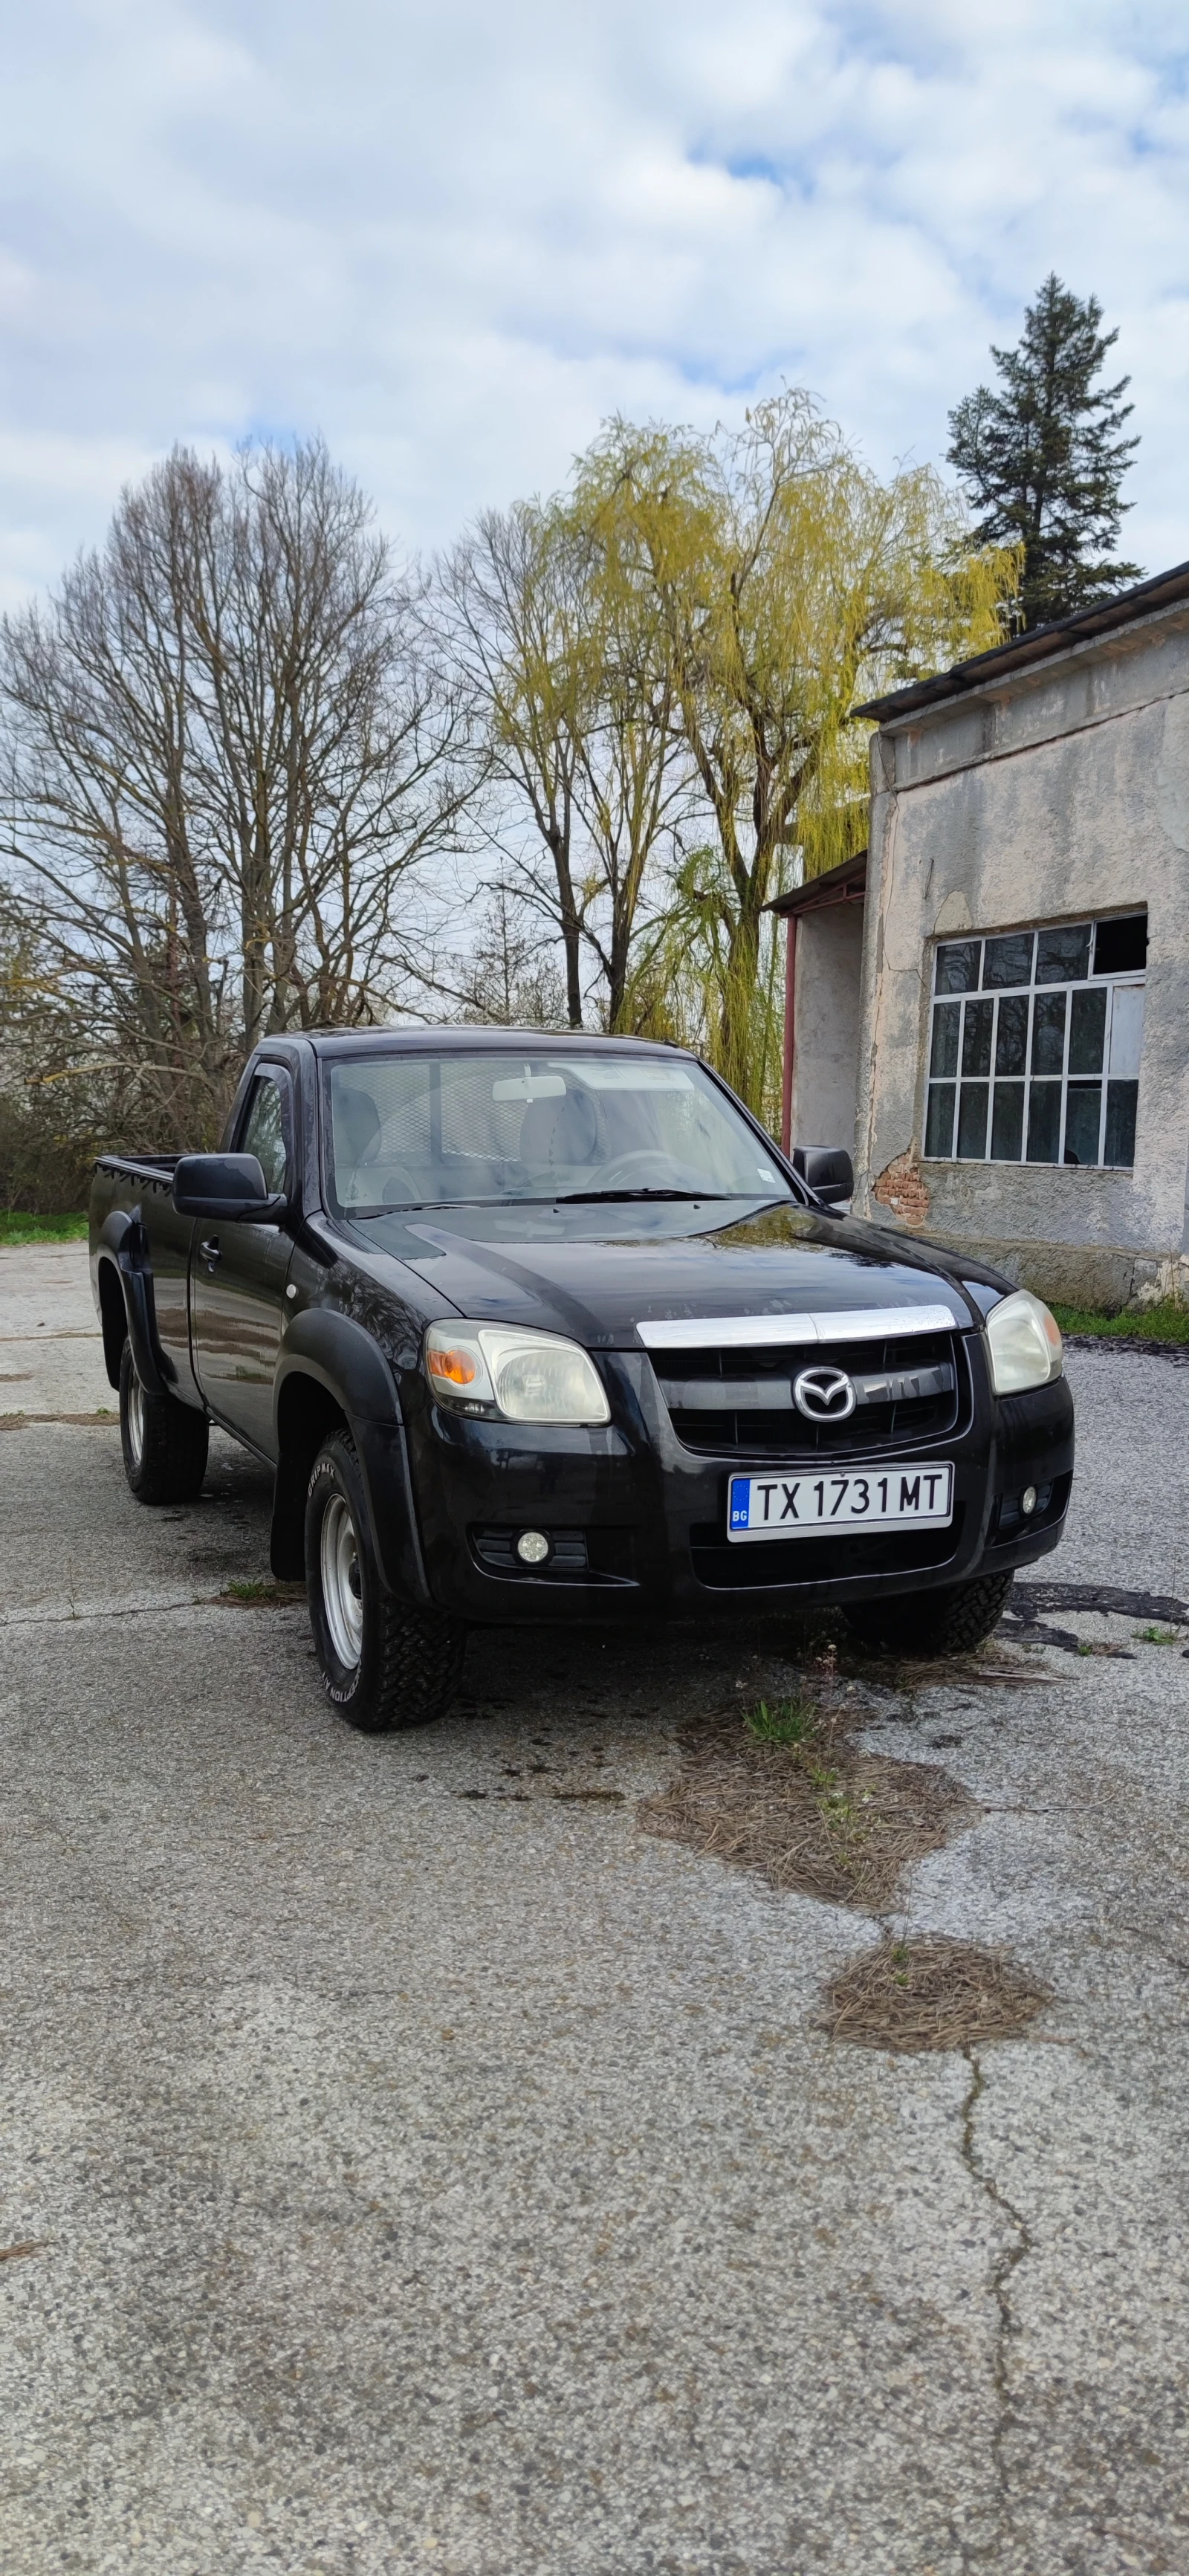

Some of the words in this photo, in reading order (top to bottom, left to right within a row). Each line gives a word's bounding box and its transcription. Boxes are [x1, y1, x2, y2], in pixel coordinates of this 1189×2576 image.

[308, 1462, 334, 1498] GRIPMAX
[757, 1482, 801, 1521] TX
[813, 1477, 889, 1518] 1731
[899, 1474, 943, 1512] MT
[732, 1509, 748, 1522] BG
[330, 1657, 362, 1703] INCEPTION
